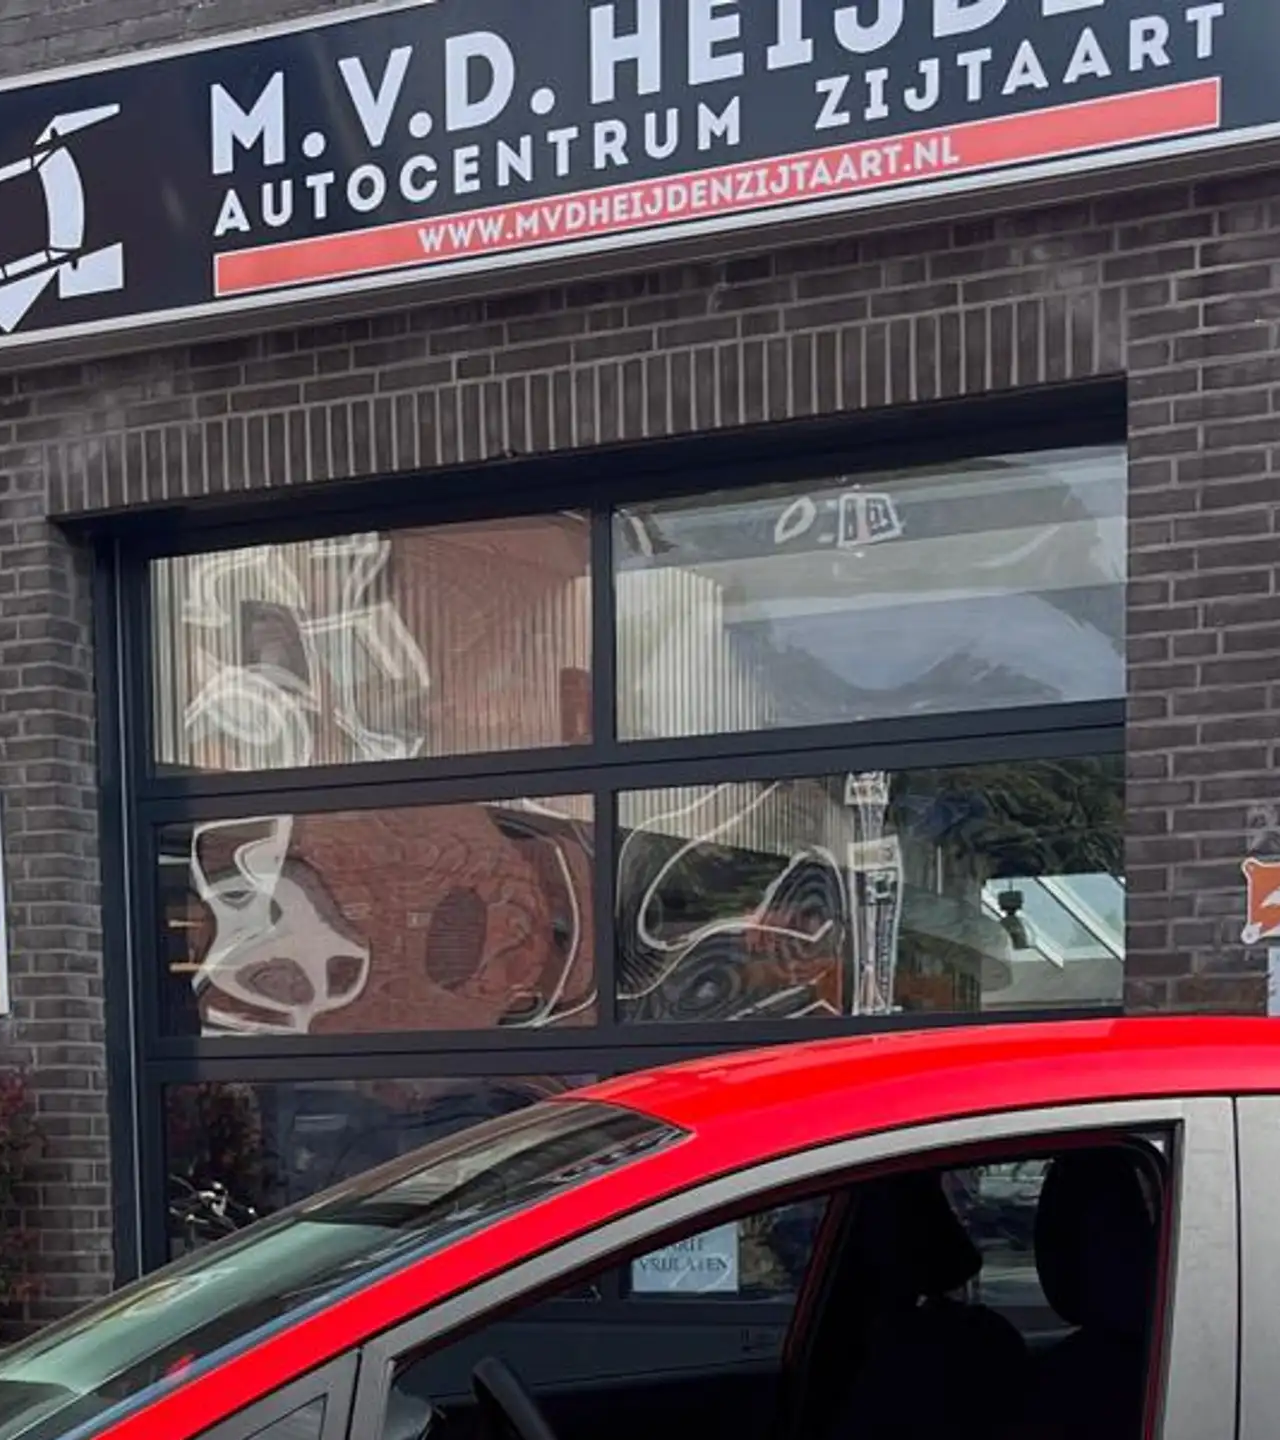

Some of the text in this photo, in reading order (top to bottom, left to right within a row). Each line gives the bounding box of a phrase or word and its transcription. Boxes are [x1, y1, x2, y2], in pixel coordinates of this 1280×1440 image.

[210, 31, 556, 175] M.V.D.
[214, 3, 1225, 236] AUTOCENTRUM ZIJTAART
[417, 134, 960, 255] WWW.MVDHEIJDENZIJTAART.NL
